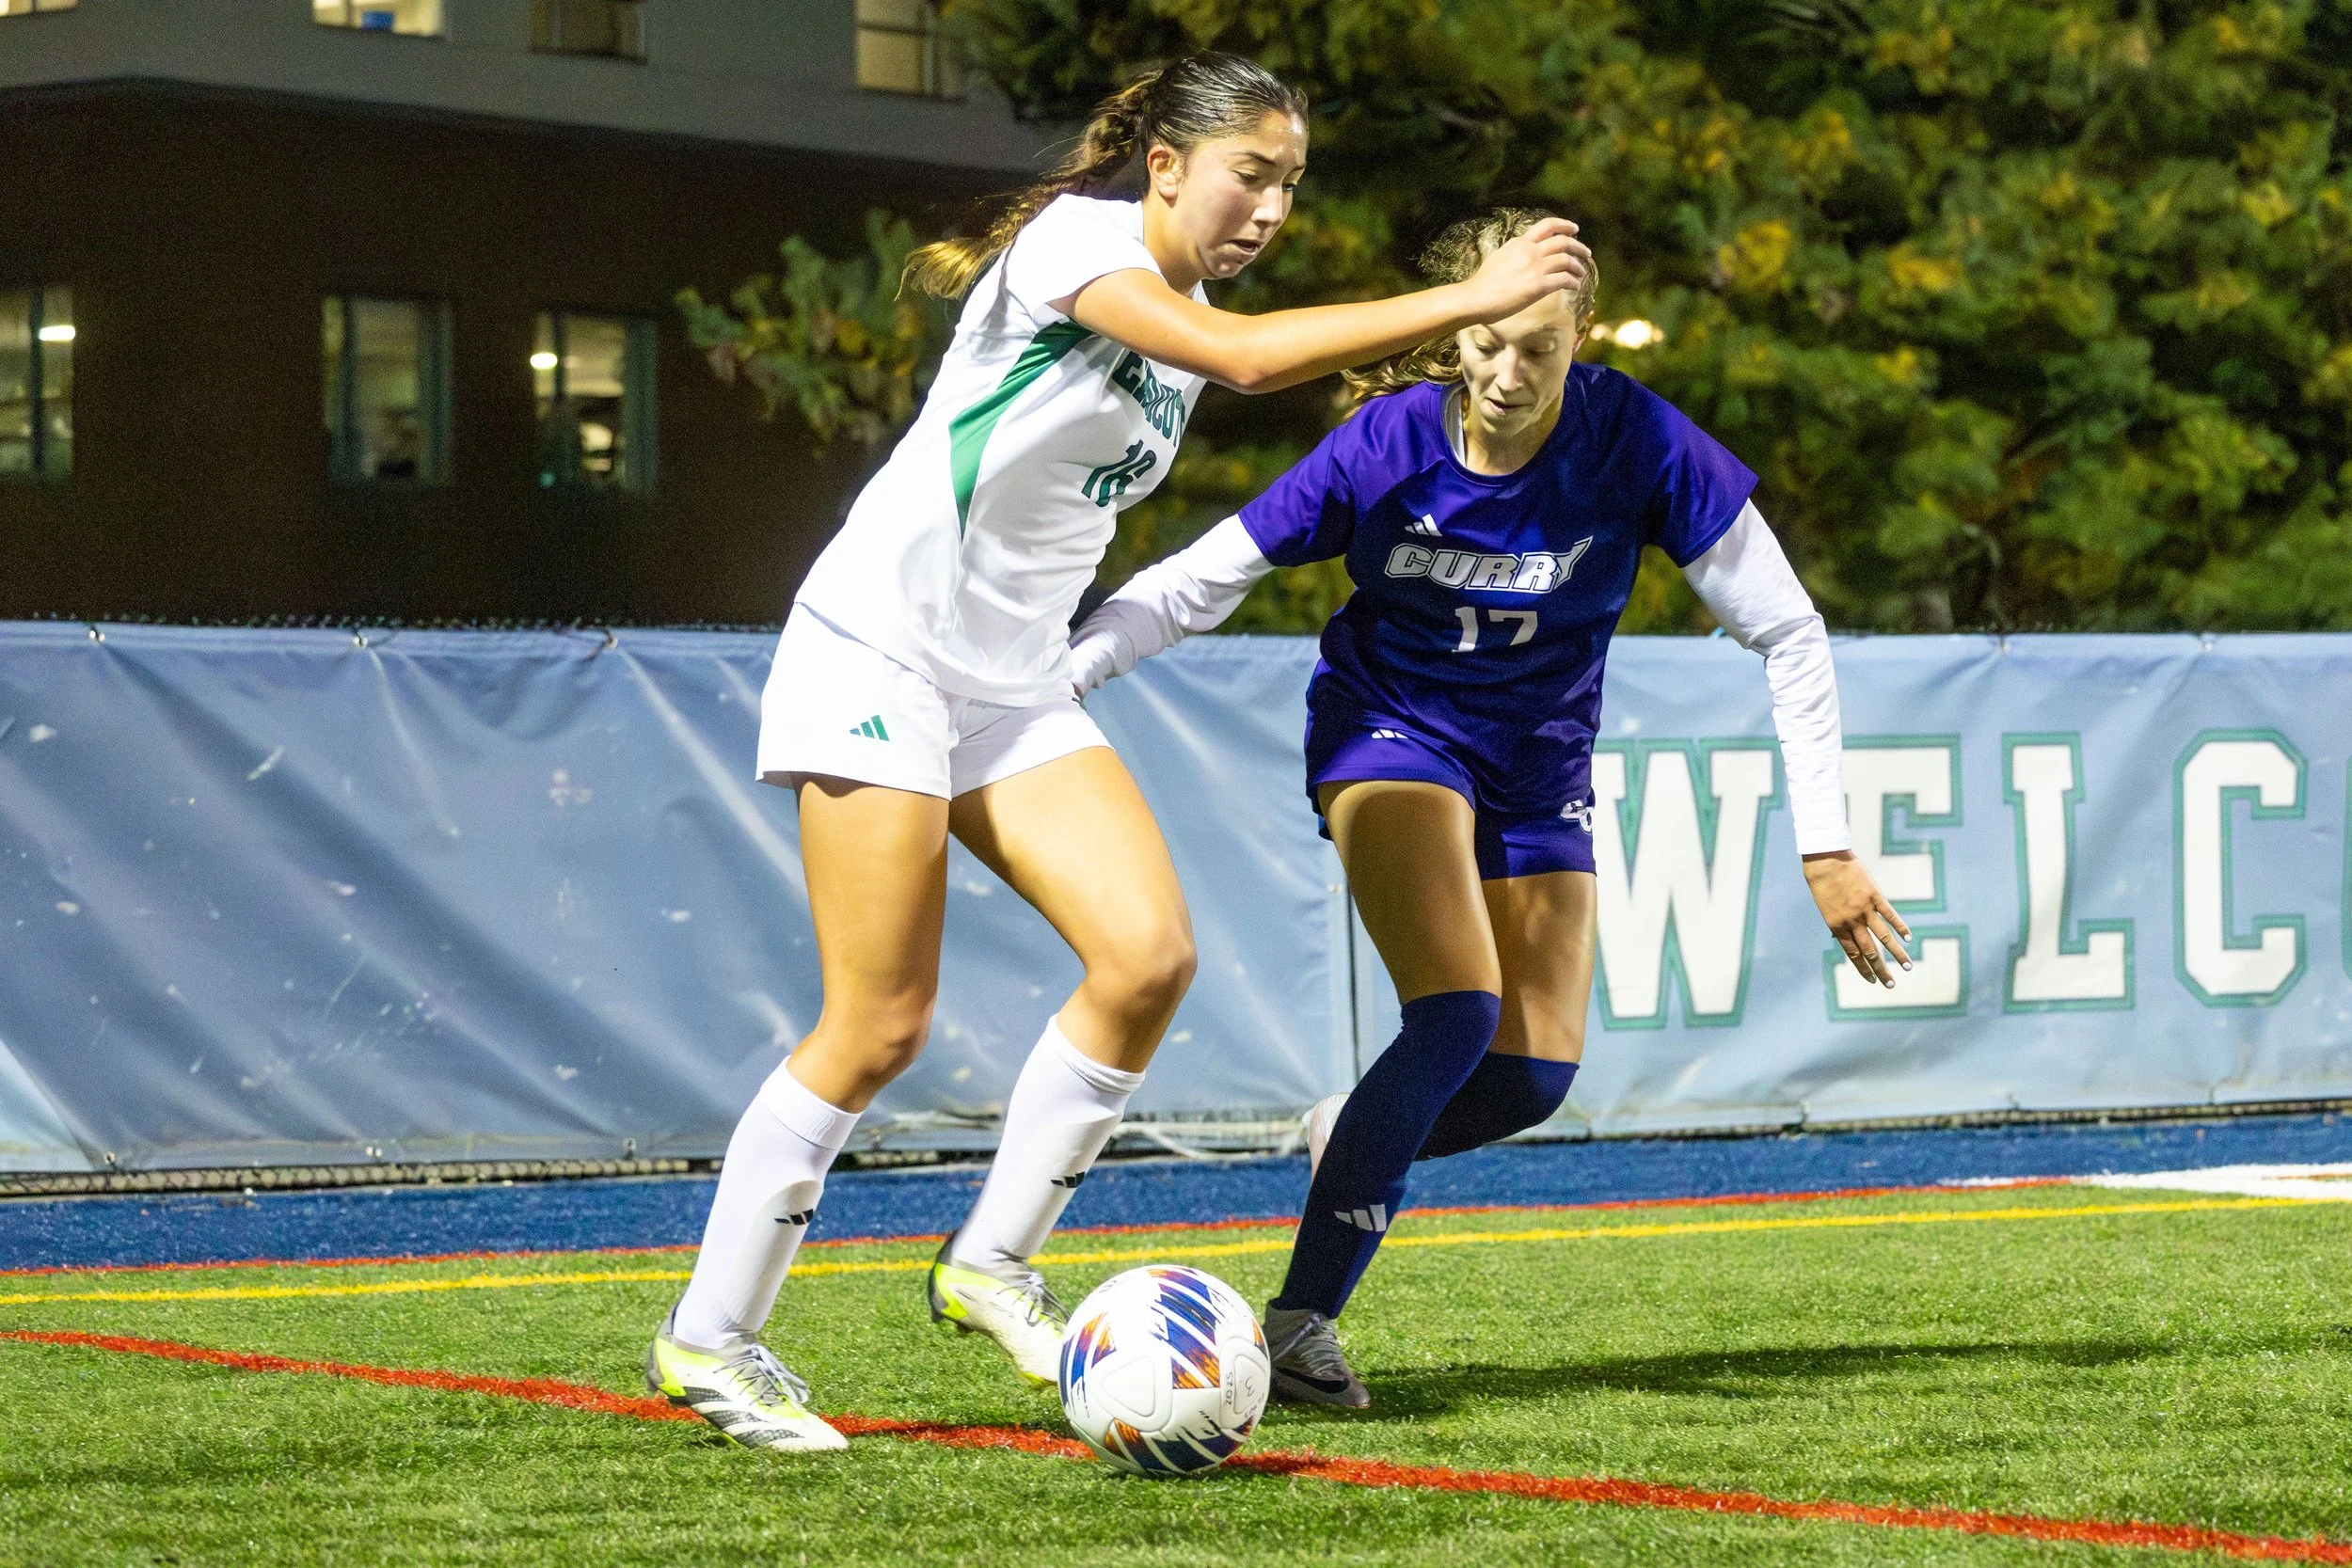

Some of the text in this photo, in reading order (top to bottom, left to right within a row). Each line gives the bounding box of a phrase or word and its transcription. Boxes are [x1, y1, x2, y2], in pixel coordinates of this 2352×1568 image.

[1081, 438, 1157, 508] 16
[1384, 534, 1594, 594] CURRY
[1452, 606, 1538, 653] 17
[1592, 727, 2352, 1031] WELC
